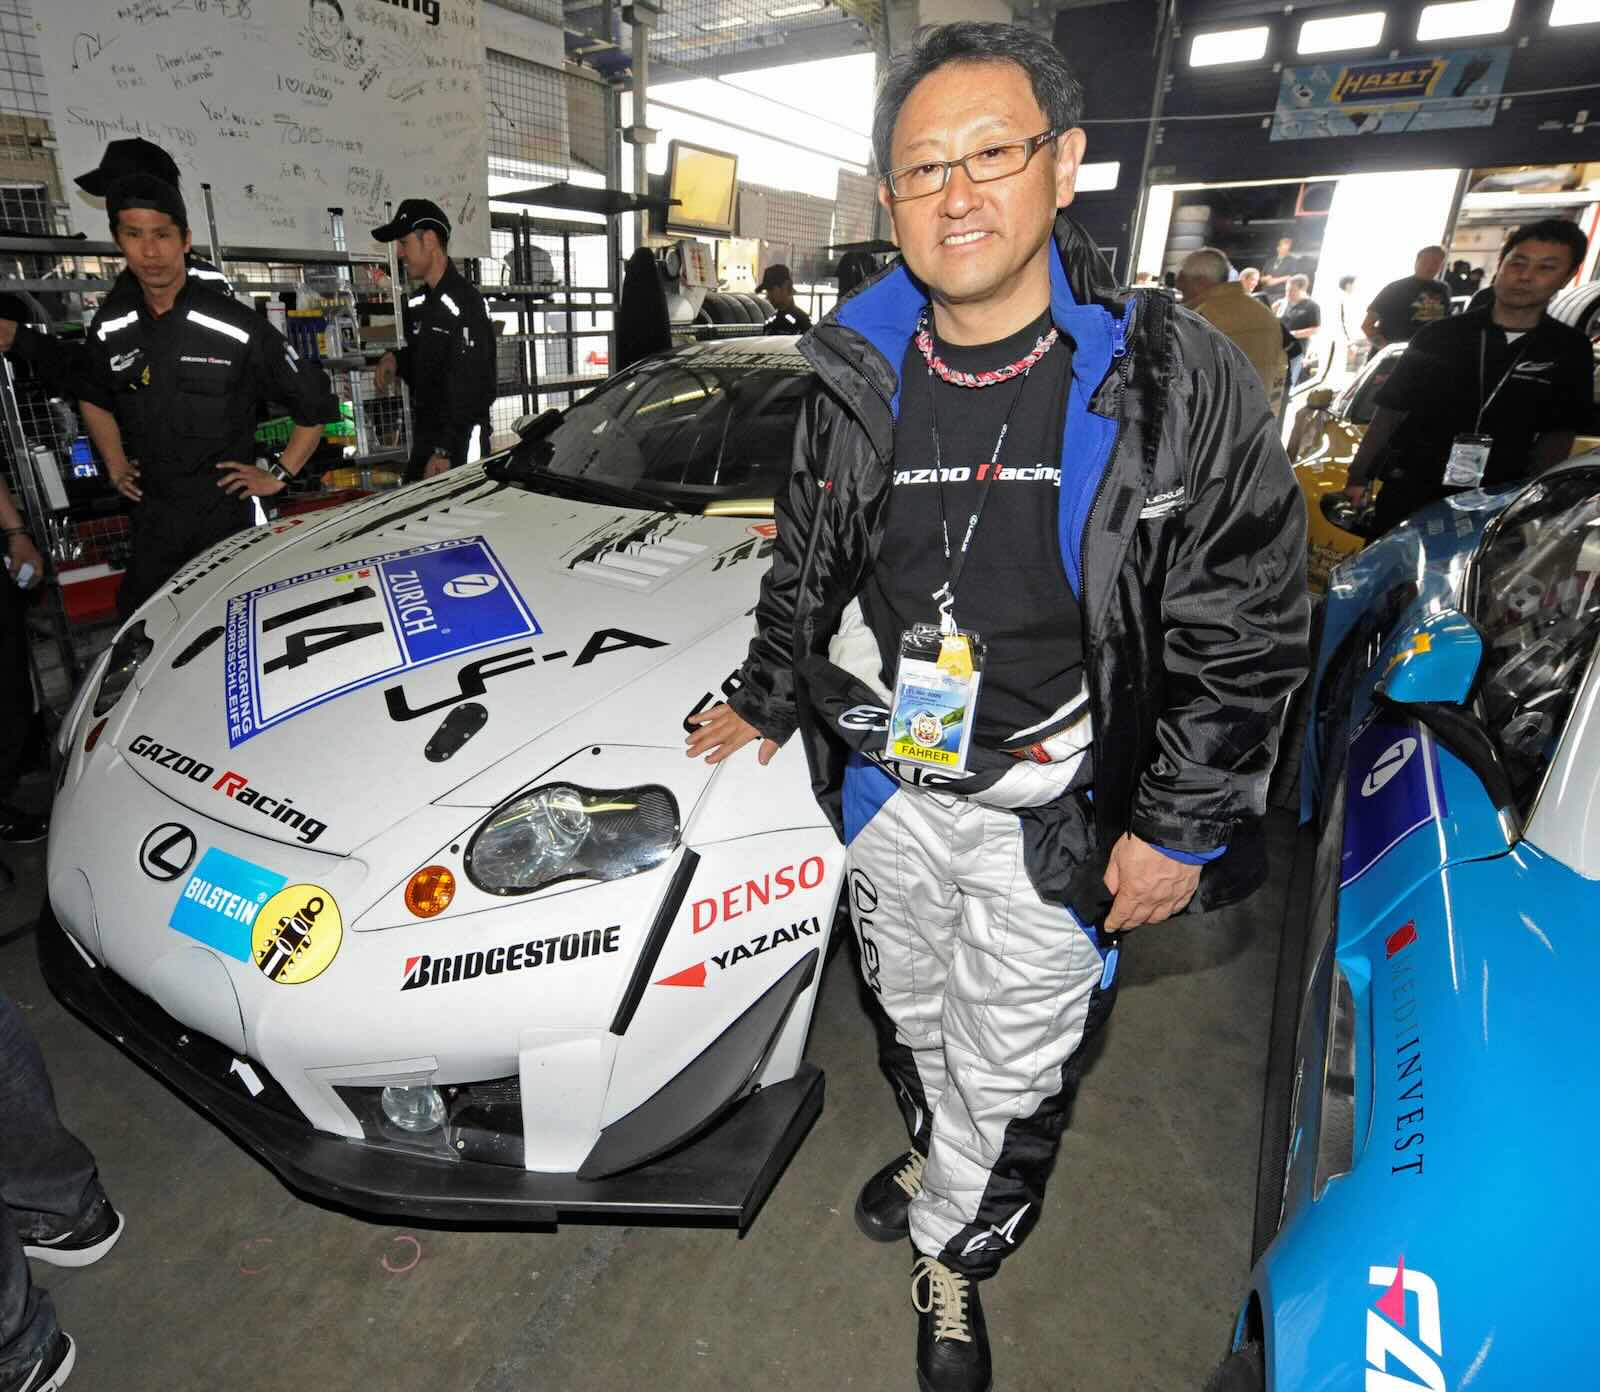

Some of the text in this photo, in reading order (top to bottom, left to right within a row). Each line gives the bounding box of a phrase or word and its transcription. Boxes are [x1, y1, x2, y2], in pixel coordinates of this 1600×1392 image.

[1341, 68, 1432, 95] HAZET
[893, 466, 971, 486] AZOO
[261, 584, 386, 676] 14
[901, 745, 950, 762] FAHRER
[128, 735, 327, 844] GAZOO Racing
[184, 876, 260, 926] BILSTEIN
[691, 855, 825, 934] DENSO
[400, 924, 621, 991] BRIDGESTONE
[711, 916, 821, 970] YAZAKI
